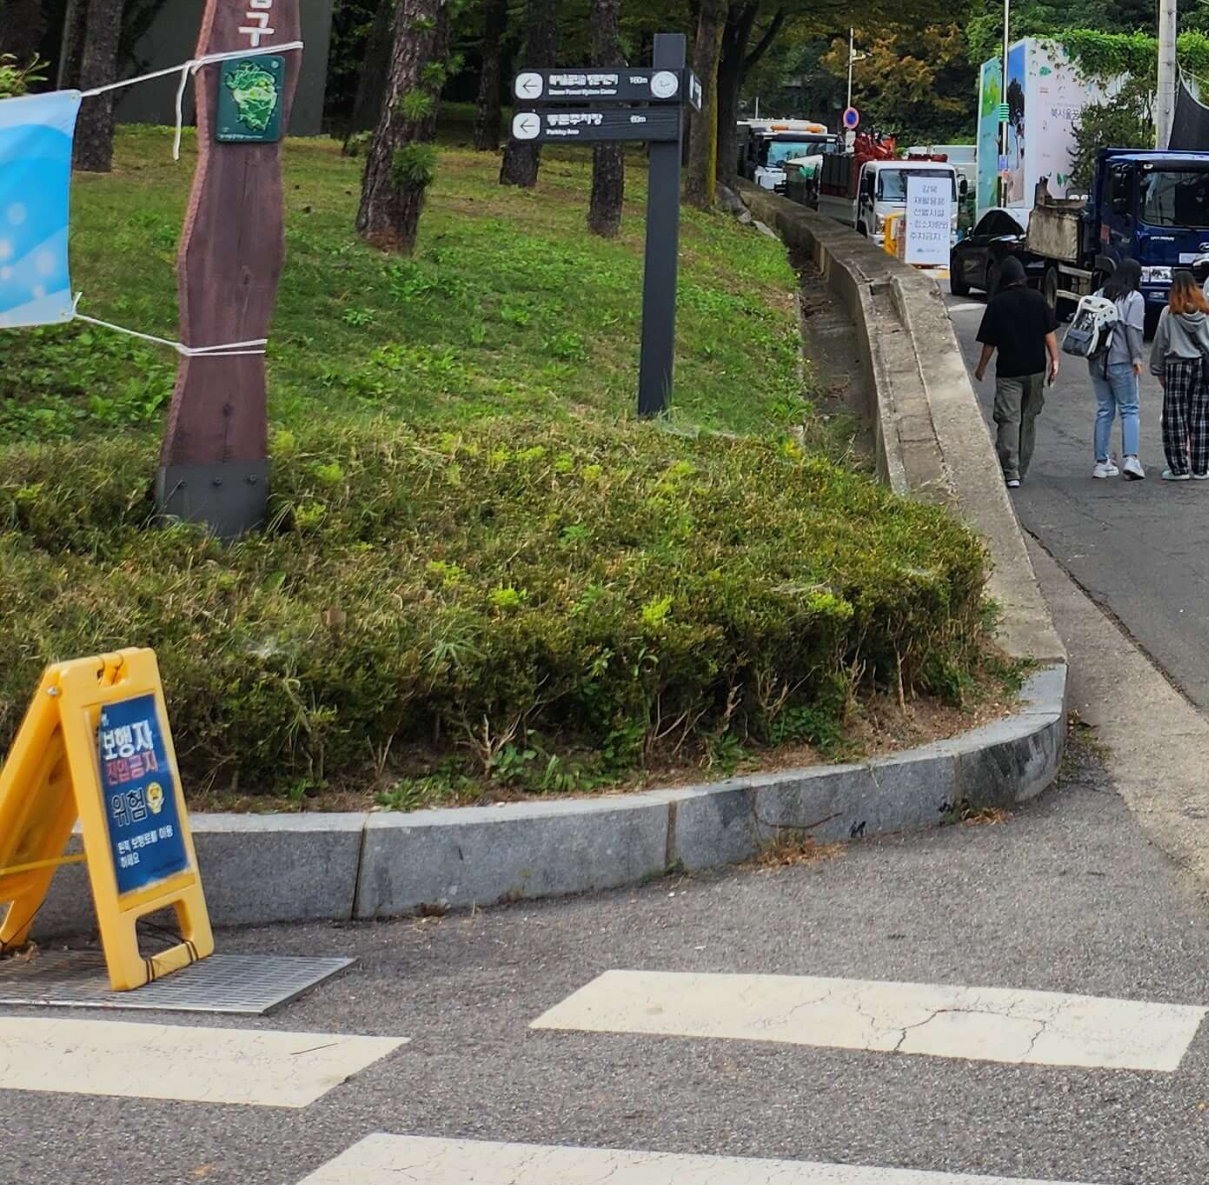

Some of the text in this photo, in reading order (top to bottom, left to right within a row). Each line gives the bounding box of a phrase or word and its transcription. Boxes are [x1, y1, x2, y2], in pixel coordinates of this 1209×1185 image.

[102, 719, 154, 761] 보행자
[106, 750, 159, 786] 진입금지
[111, 787, 148, 827] 위험
[158, 824, 174, 839] 이용
